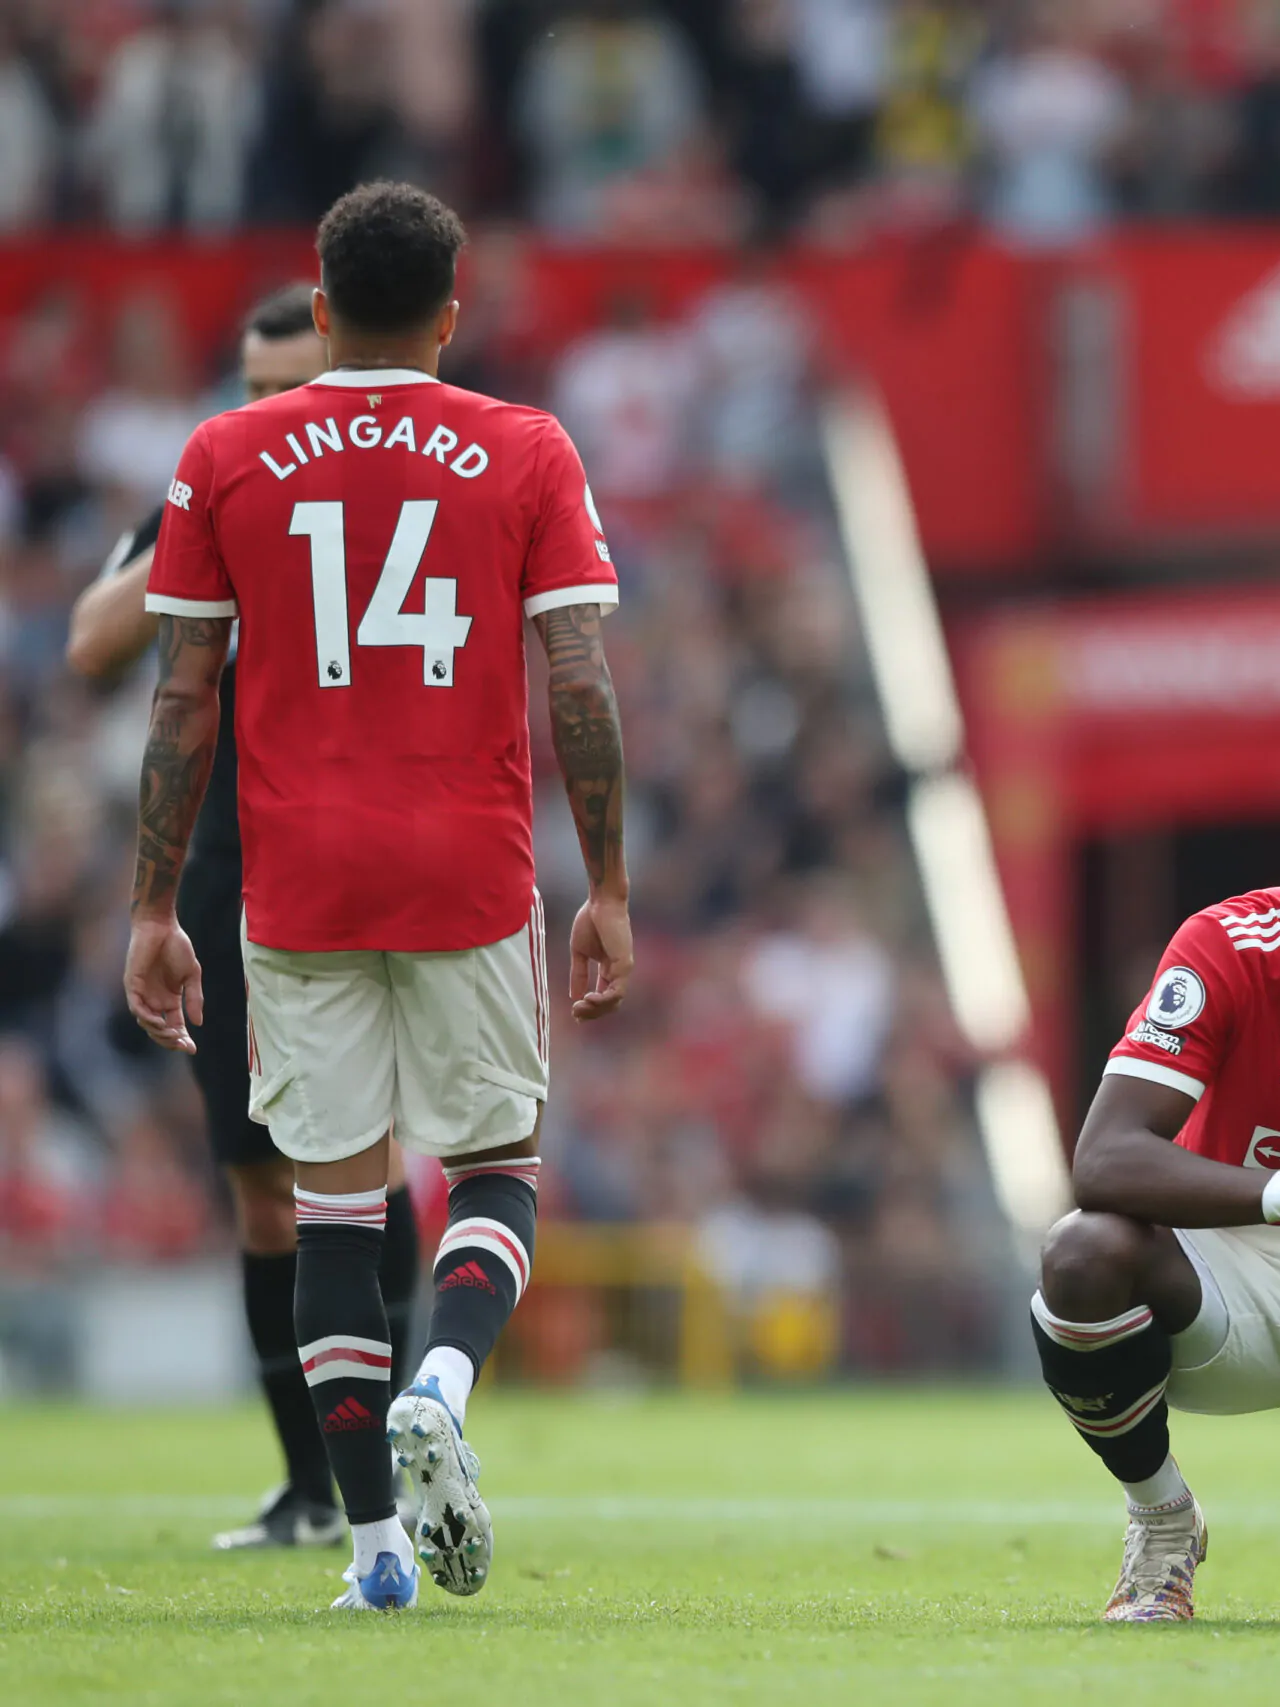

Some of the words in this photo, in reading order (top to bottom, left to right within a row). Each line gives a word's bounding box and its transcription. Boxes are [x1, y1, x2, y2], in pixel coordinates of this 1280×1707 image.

[258, 414, 490, 481] LINGARD
[167, 478, 193, 511] LER
[287, 499, 474, 688] 14
